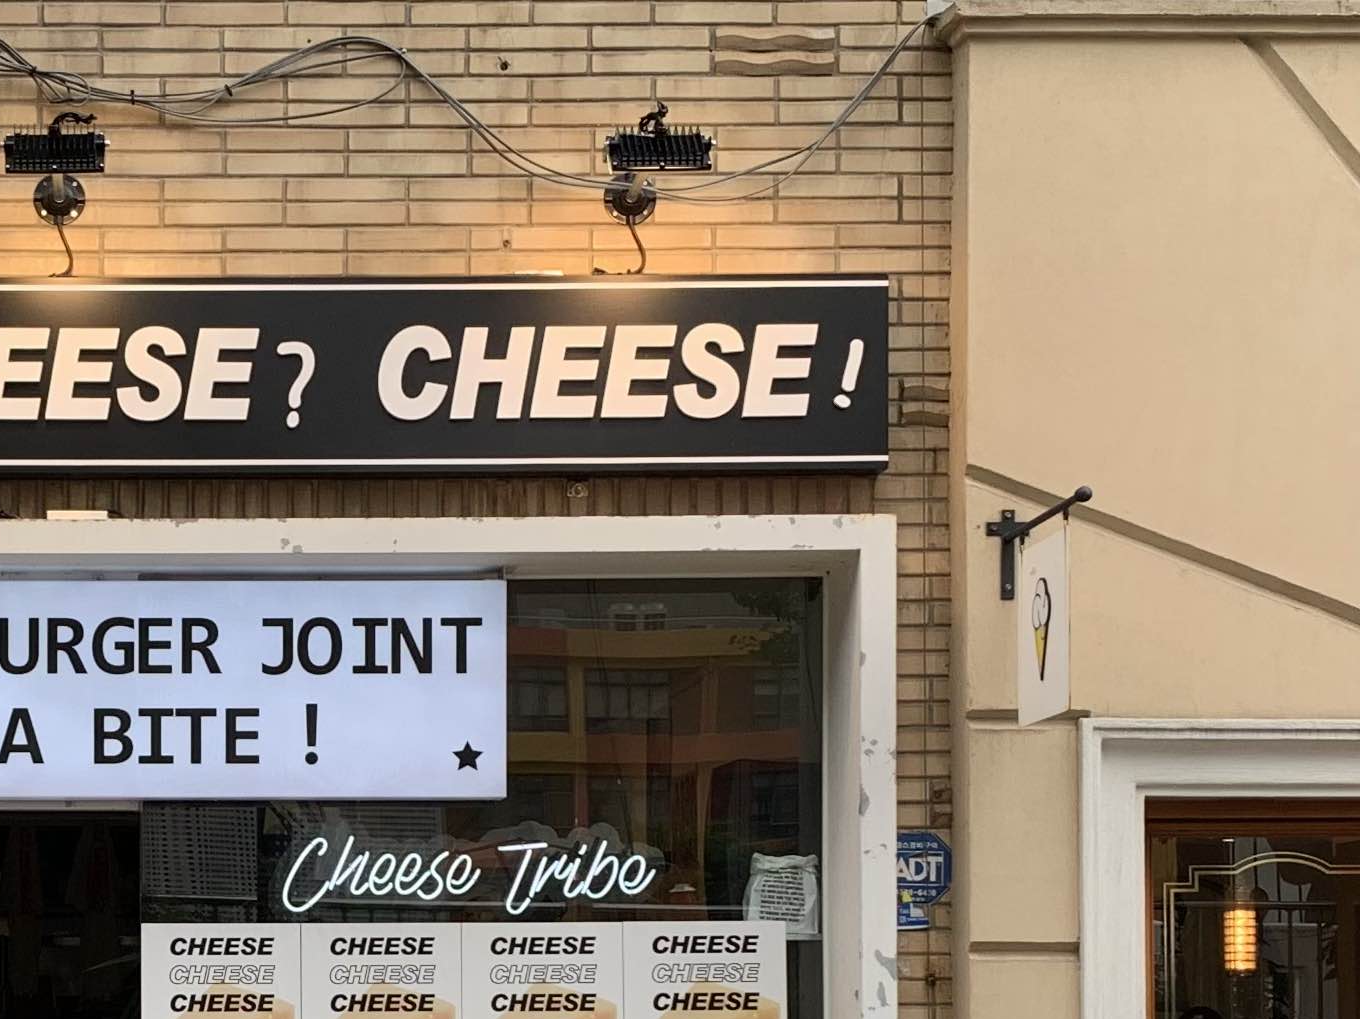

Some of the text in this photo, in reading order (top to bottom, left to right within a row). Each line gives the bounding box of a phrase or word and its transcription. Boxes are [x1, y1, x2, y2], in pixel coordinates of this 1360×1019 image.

[377, 322, 864, 422] CHEESE!
[261, 616, 483, 676] JOINT
[93, 707, 260, 765] BITE
[282, 835, 656, 915] Cheese Tribe
[896, 855, 944, 882] ADT
[170, 937, 274, 956] CHEESE
[330, 937, 435, 956] CHEESE
[490, 936, 596, 955] CHEESE
[652, 935, 759, 954] CHEESE
[169, 965, 275, 985] CHEESE
[330, 964, 435, 984] CHEESE
[490, 964, 597, 984] CHEESE
[652, 963, 760, 983] CHEESE
[170, 994, 274, 1012] CHEESE
[330, 994, 435, 1012] CHEESE
[491, 993, 596, 1012] CHEESE
[653, 992, 759, 1011] CHEESE
